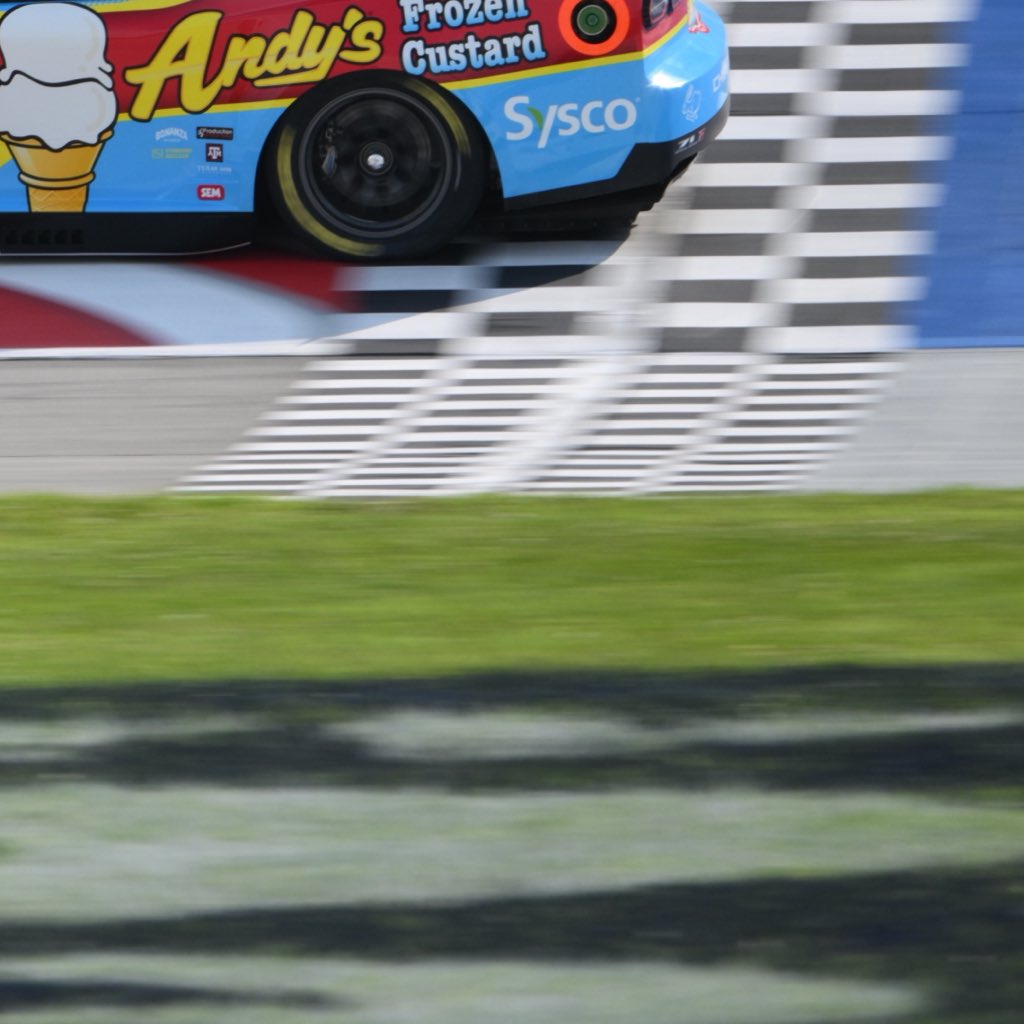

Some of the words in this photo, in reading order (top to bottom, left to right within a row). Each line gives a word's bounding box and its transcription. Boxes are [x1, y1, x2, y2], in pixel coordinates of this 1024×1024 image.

[124, 5, 385, 121] Andy's
[401, 24, 547, 75] Custard
[200, 187, 222, 198] SEM
